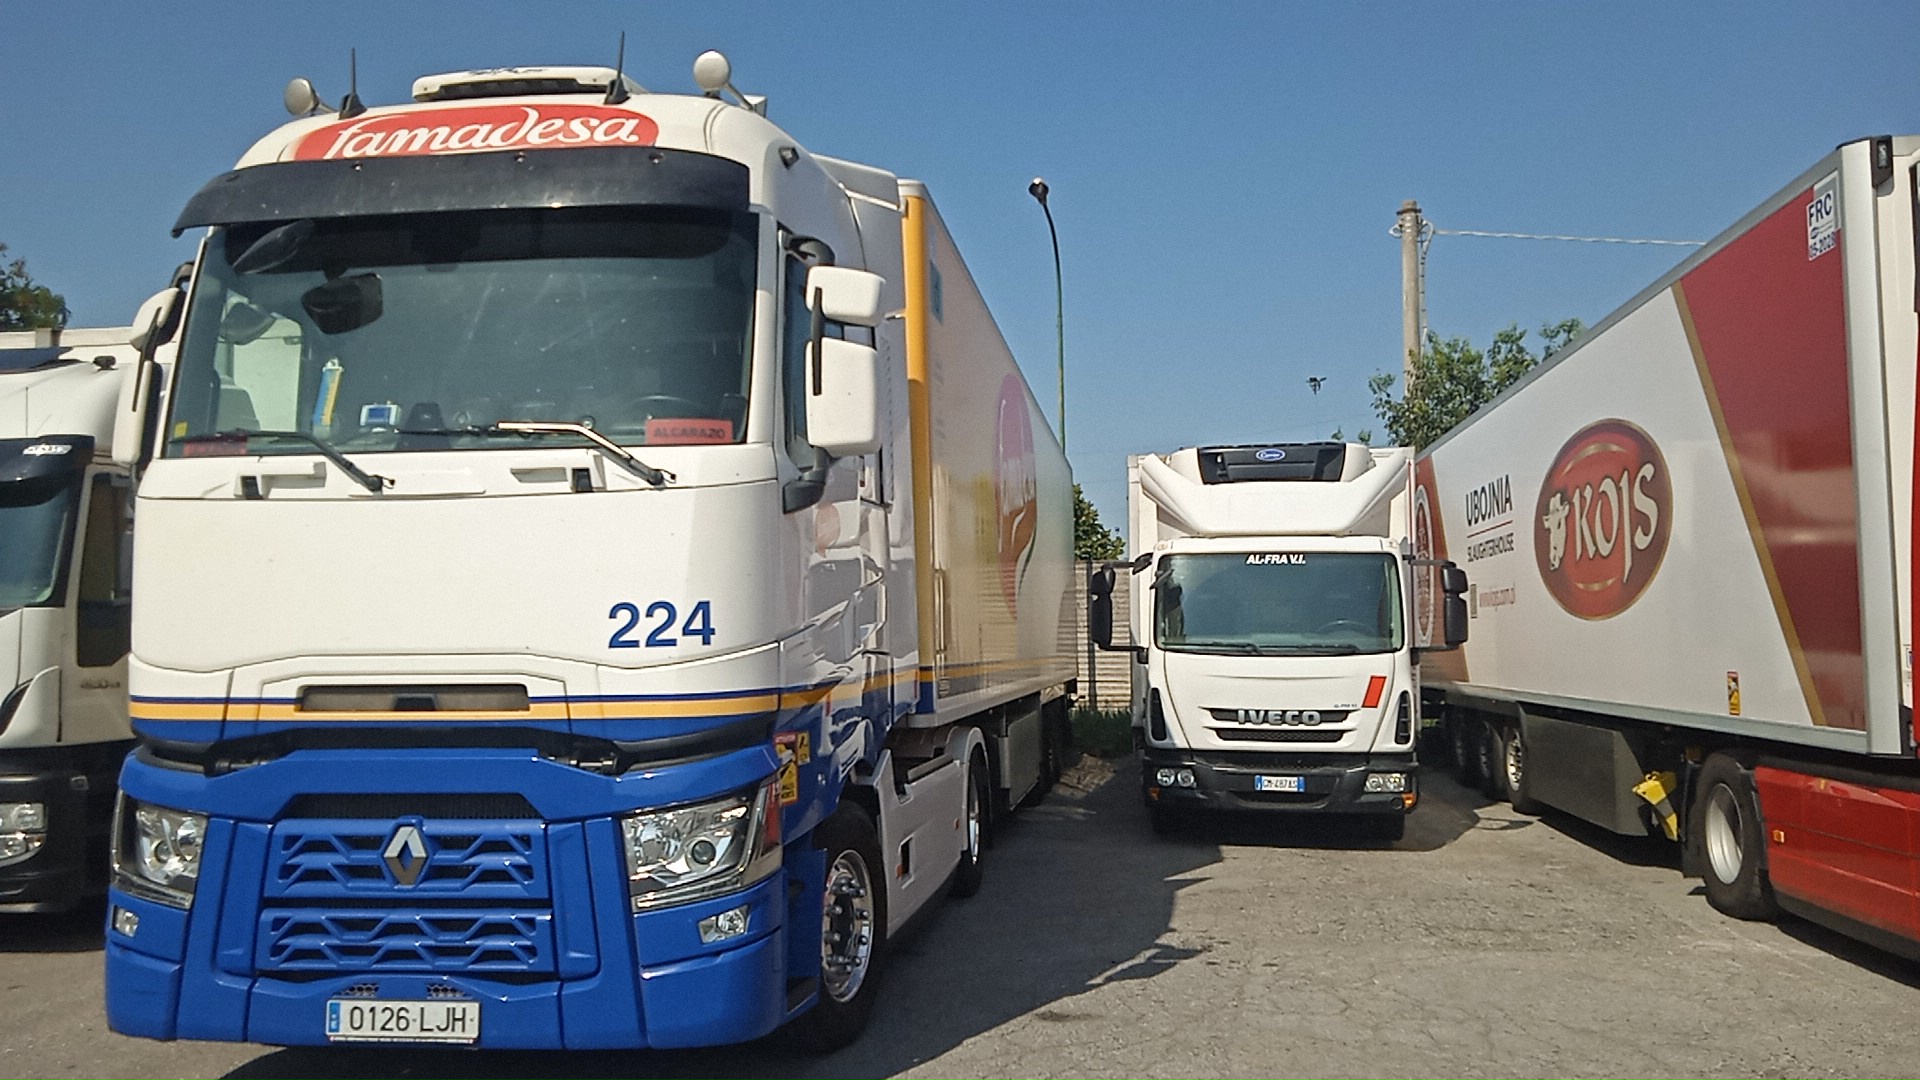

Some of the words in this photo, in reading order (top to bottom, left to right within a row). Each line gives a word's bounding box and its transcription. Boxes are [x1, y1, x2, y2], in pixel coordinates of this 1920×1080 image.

[322, 106, 640, 159] famadesa
[1808, 193, 1832, 227] FRC
[1466, 474, 1513, 526] UBOJNIA
[1467, 532, 1514, 562] SLAUGHTERHOUSE
[608, 600, 716, 648] 224
[1237, 709, 1321, 726] IVECO
[349, 1006, 410, 1032] 0126
[419, 1006, 466, 1033] LJH
